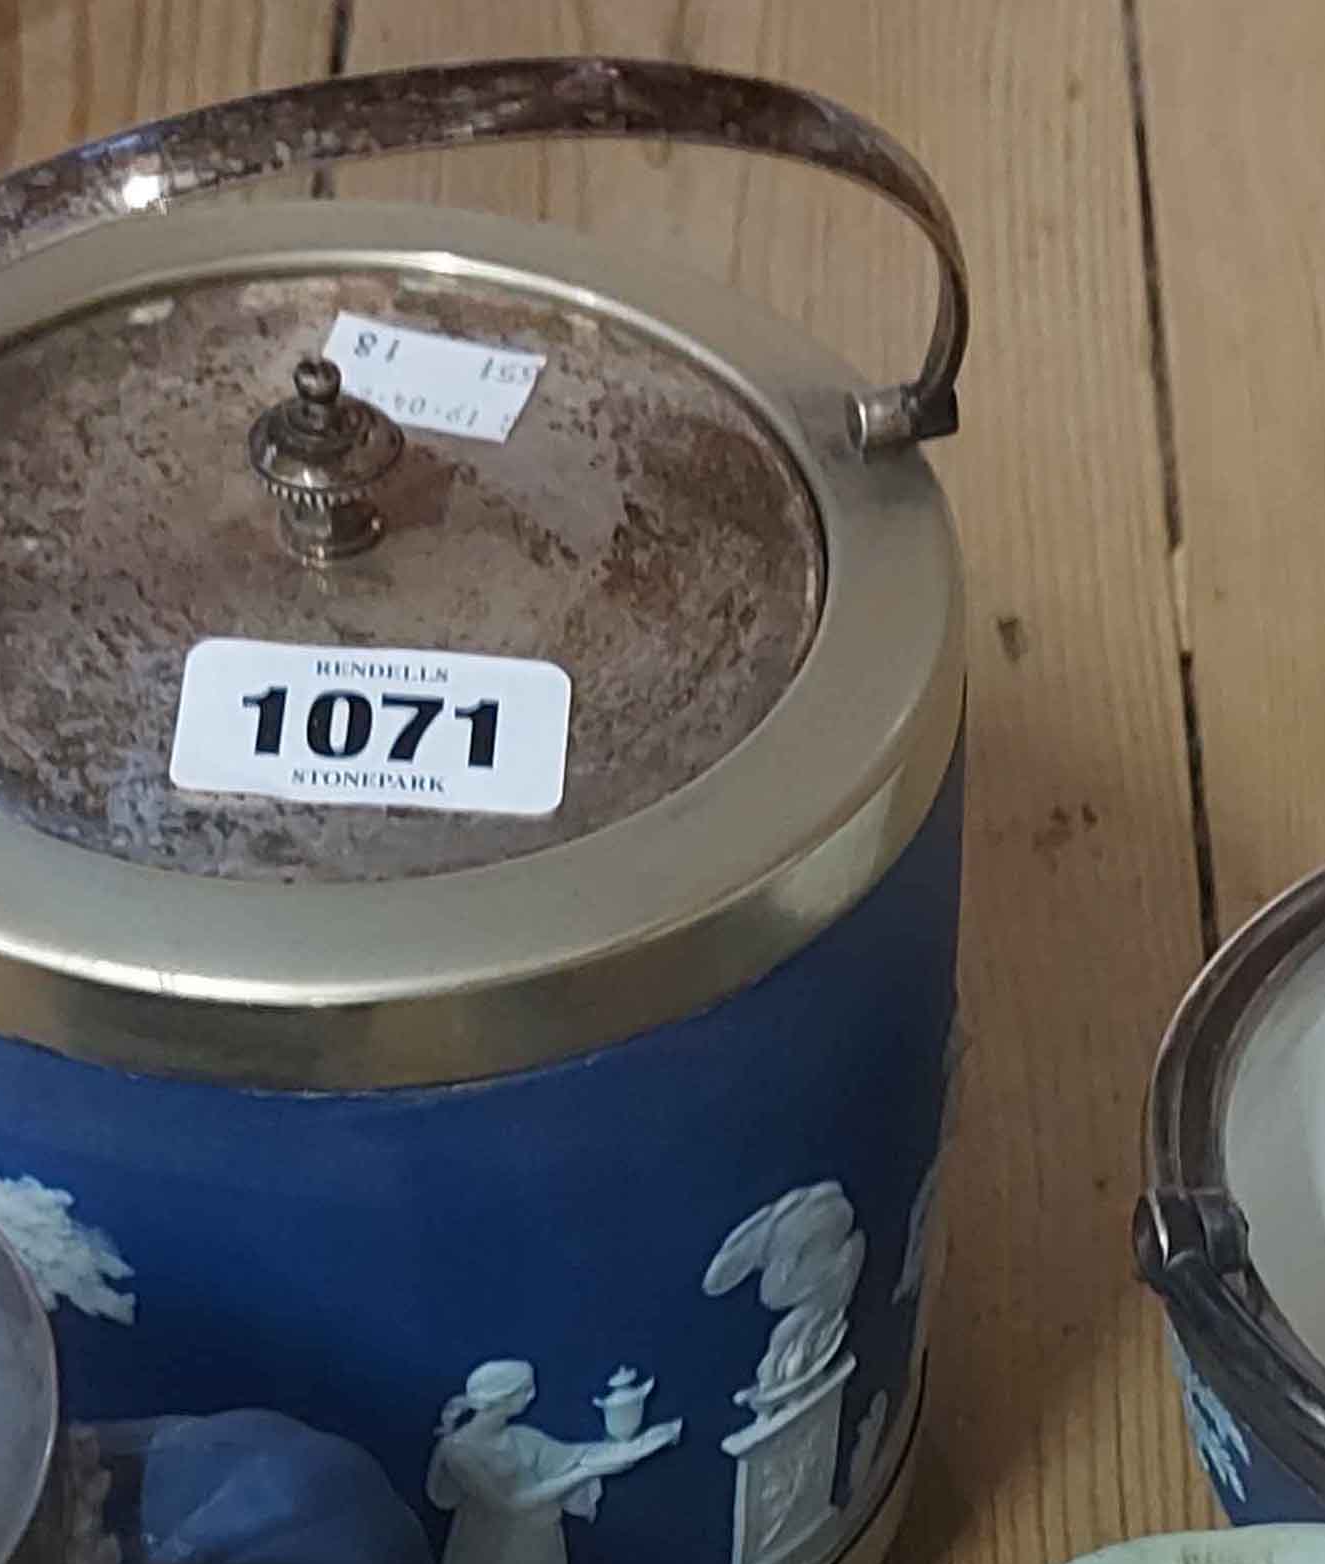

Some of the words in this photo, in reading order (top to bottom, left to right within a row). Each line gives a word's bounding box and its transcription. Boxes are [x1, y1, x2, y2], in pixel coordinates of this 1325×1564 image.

[314, 659, 450, 683] RENDELLS
[242, 685, 501, 768] 1071
[290, 767, 447, 794] STONEPARK
